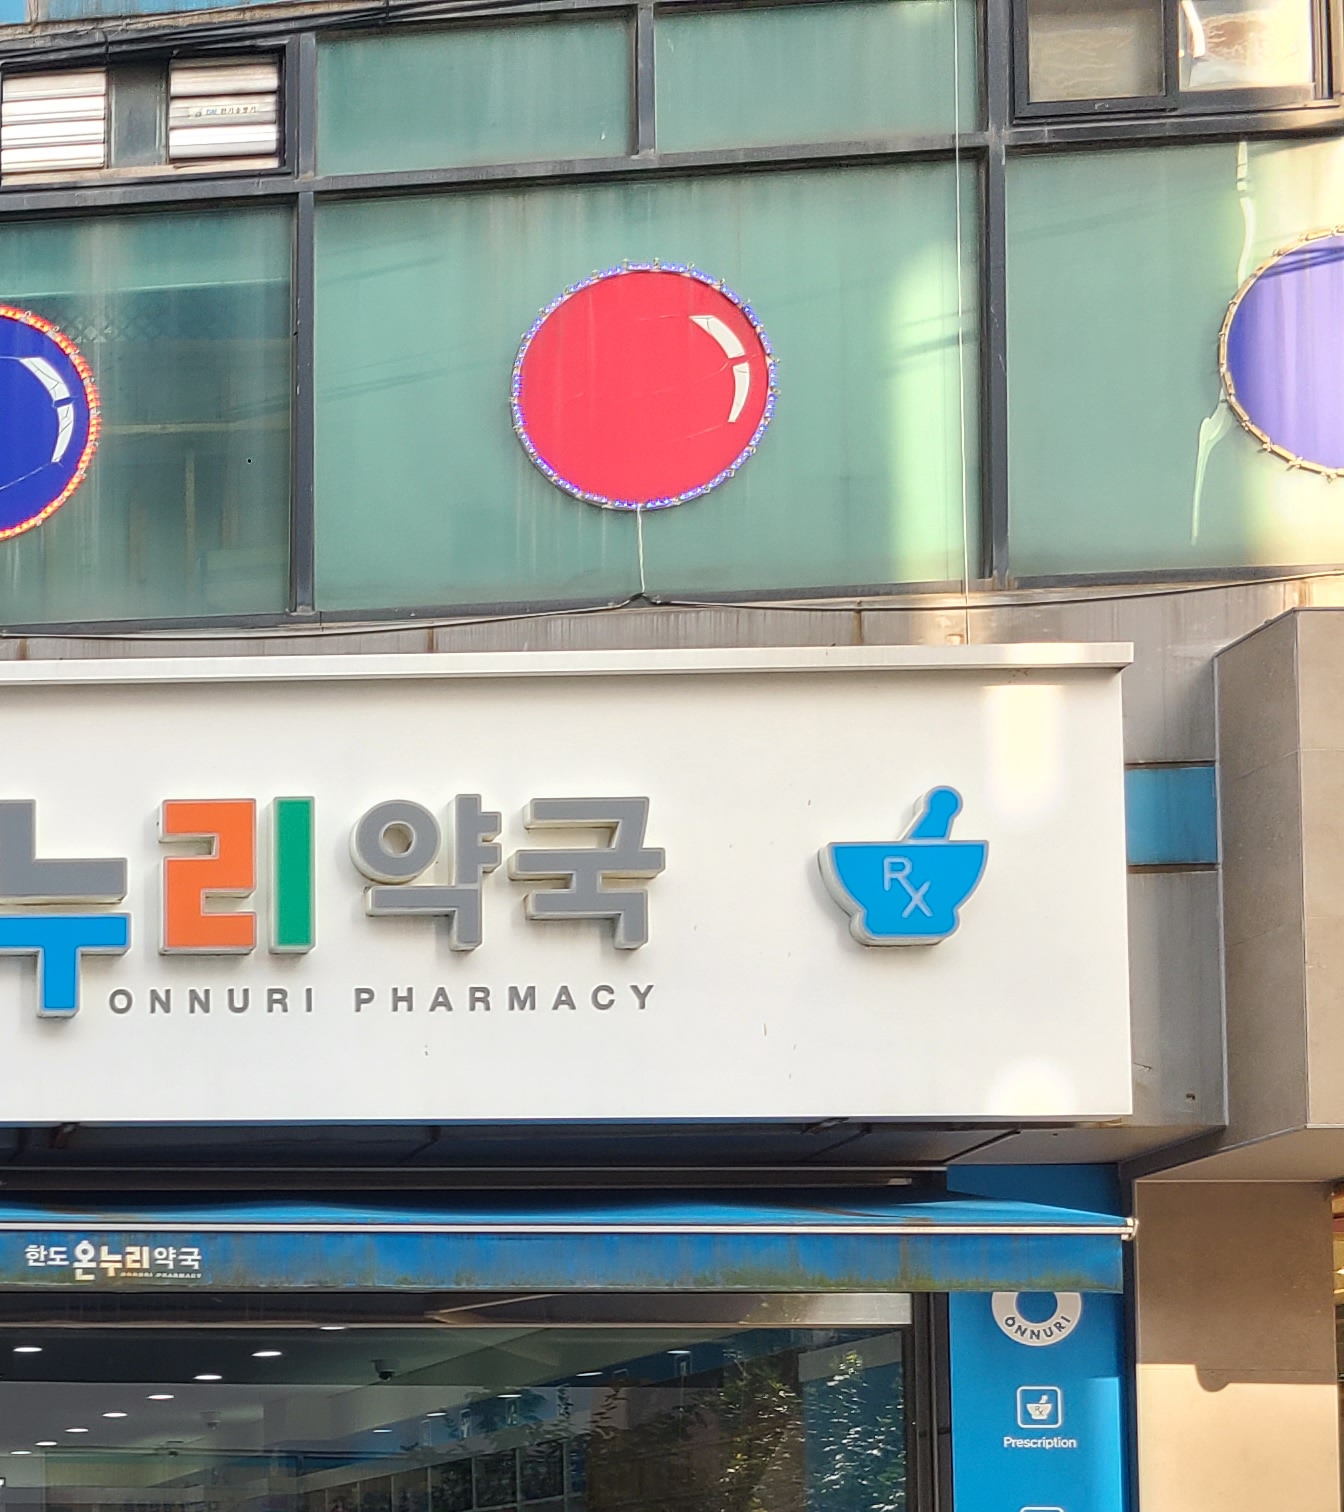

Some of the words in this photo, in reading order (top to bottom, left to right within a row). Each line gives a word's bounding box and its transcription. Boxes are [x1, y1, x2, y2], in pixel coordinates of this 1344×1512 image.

[110, 988, 313, 1015] ONNURI
[355, 985, 654, 1014] PHARMACY
[1004, 1314, 1071, 1341] ONNURI
[1004, 1436, 1077, 1450] Prescription
